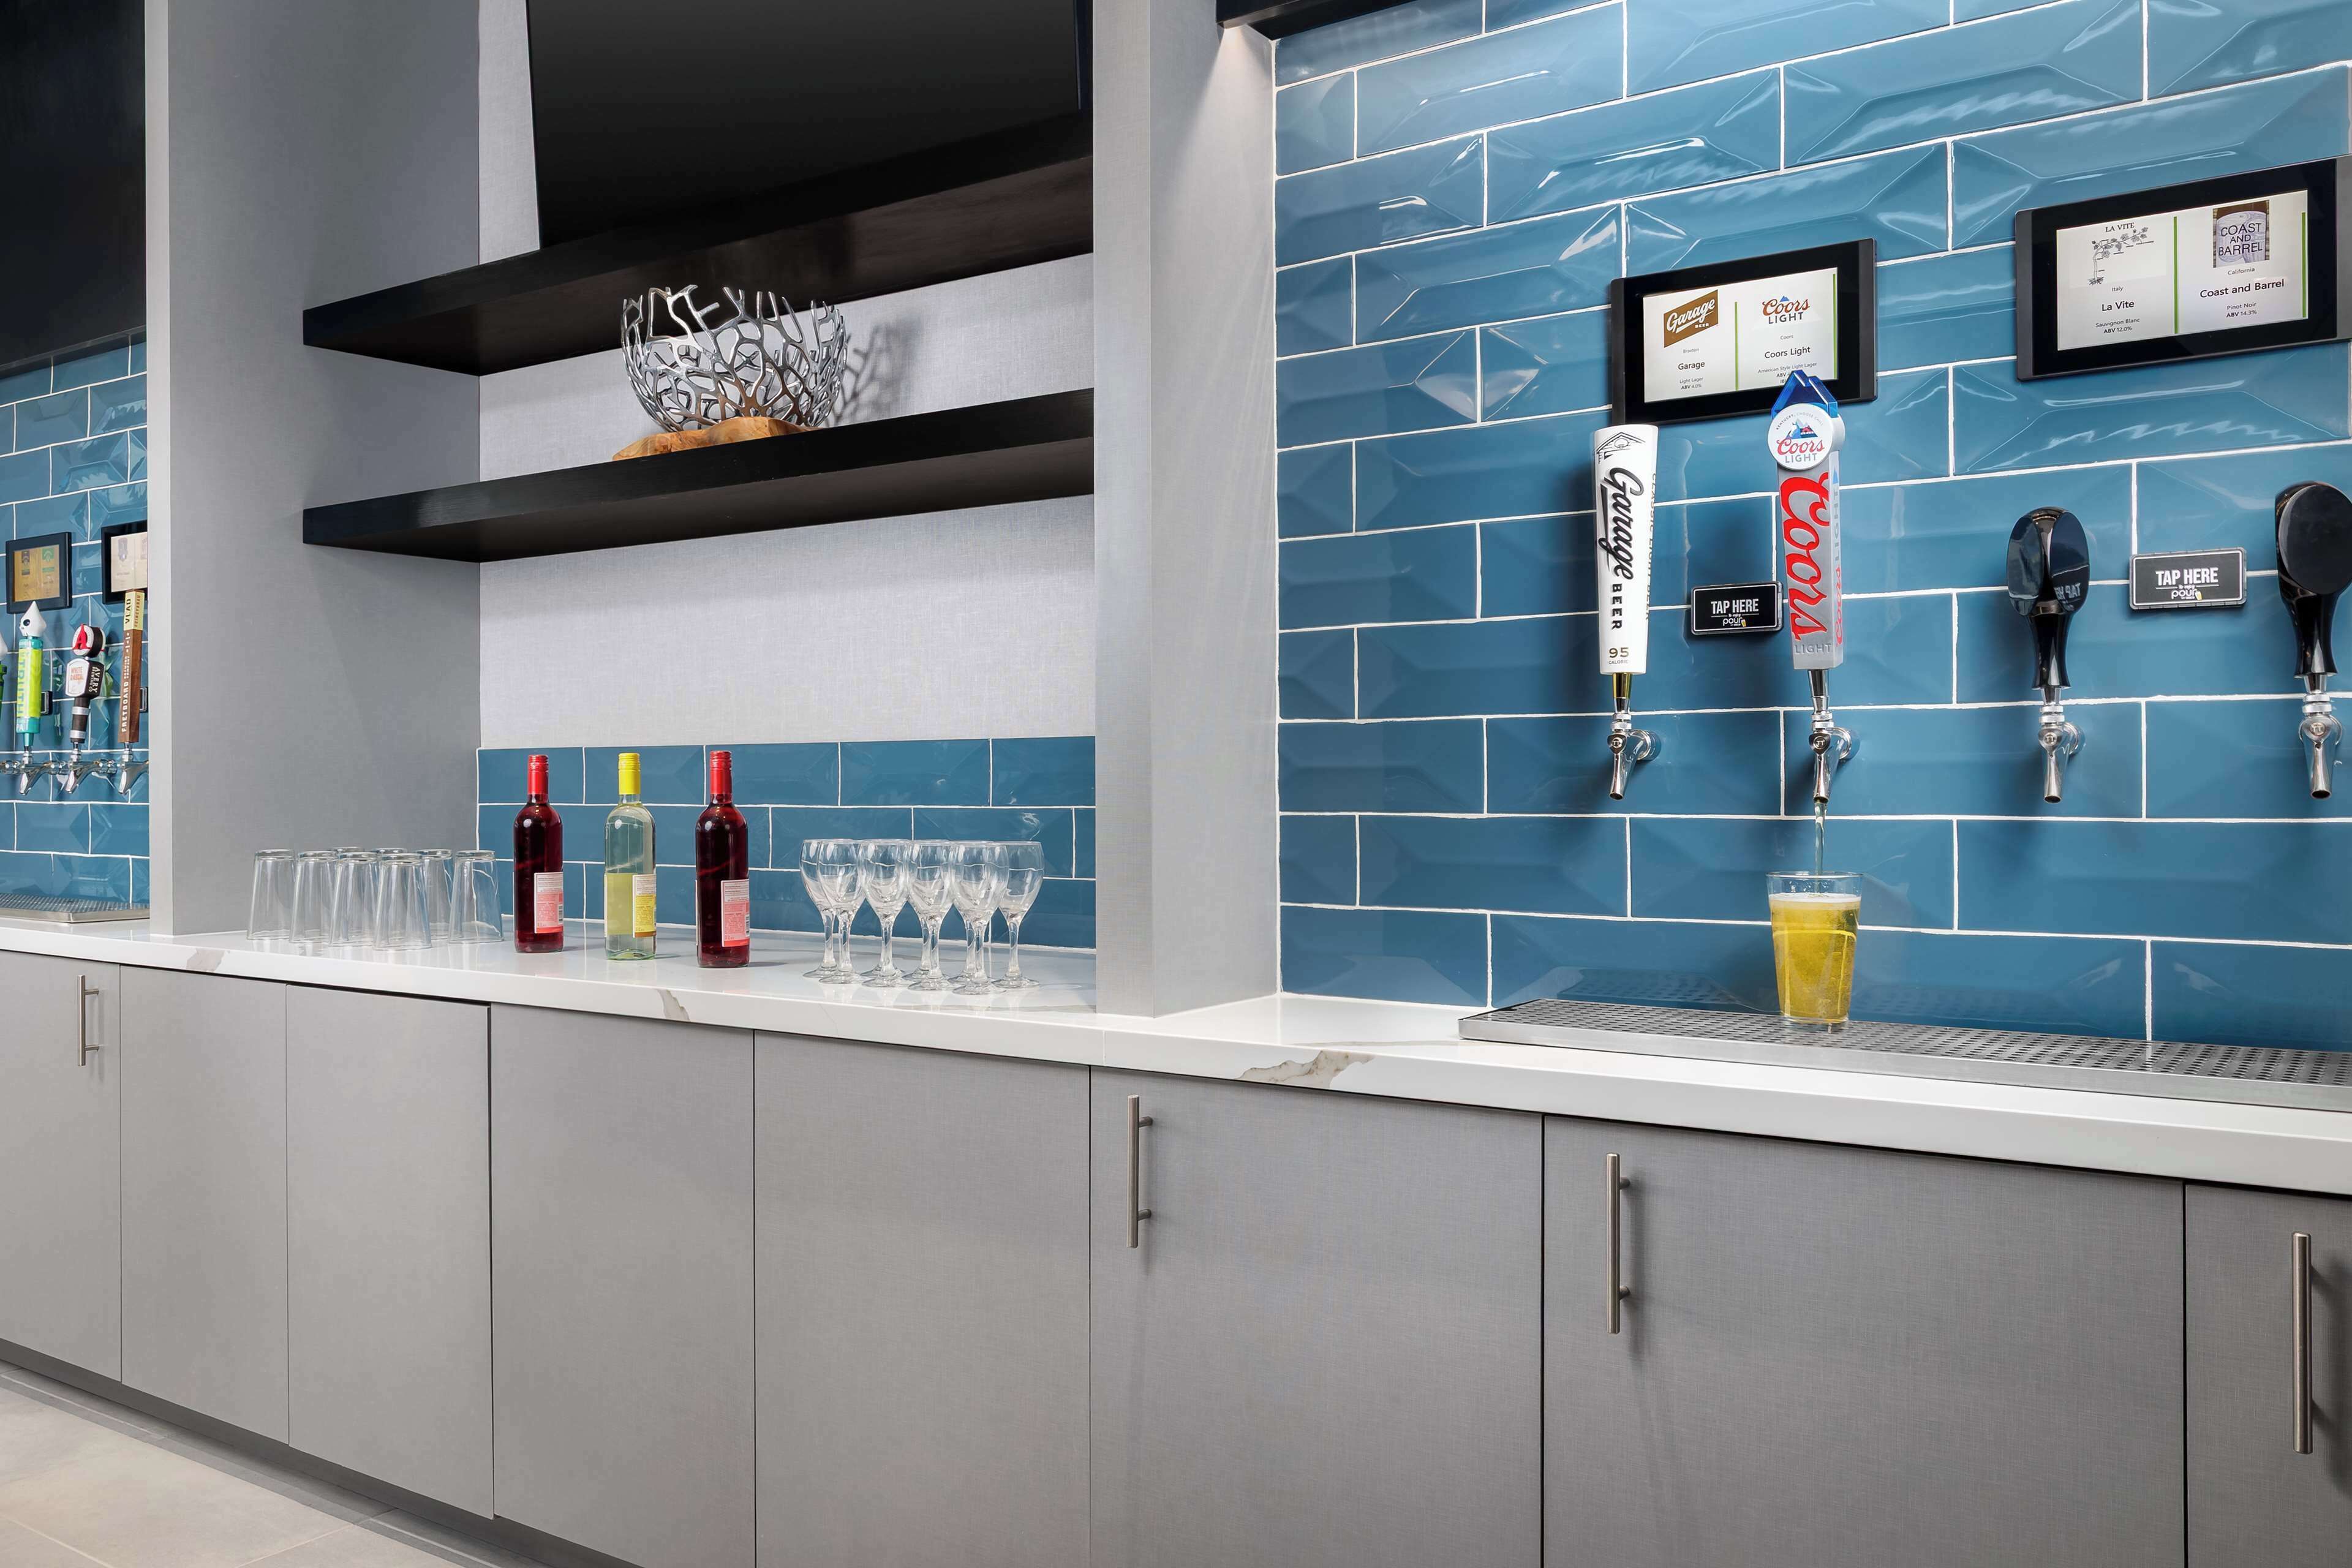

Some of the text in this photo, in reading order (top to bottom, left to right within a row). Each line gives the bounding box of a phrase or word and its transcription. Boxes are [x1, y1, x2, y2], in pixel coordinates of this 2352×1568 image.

[2117, 222, 2135, 231] VITE
[2220, 223, 2261, 237] COAST
[2230, 235, 2251, 244] AND
[2218, 242, 2263, 256] BARREL
[2200, 279, 2284, 298] Coast and Barrel
[1762, 299, 1810, 316] Coors
[2115, 300, 2135, 309] Vite
[1666, 298, 1715, 333] Garage
[1768, 312, 1804, 325] LIGHT
[2095, 320, 2124, 328] Sauvignon
[1764, 346, 1811, 359] Coors Light
[1678, 361, 1705, 371] Garage
[1776, 438, 1825, 455] Coors
[1785, 453, 1817, 463] LIGHT
[1598, 467, 1645, 630] Garage BEER
[1781, 471, 1830, 641] Coors
[2155, 567, 2218, 586] TAP HERE
[2171, 589, 2197, 600] pour
[1711, 598, 1759, 614] TAP HERE
[1722, 617, 1743, 626] pour
[1608, 647, 1629, 658] 95
[1795, 643, 1832, 654] LIGHT
[91, 666, 101, 693] AVERY
